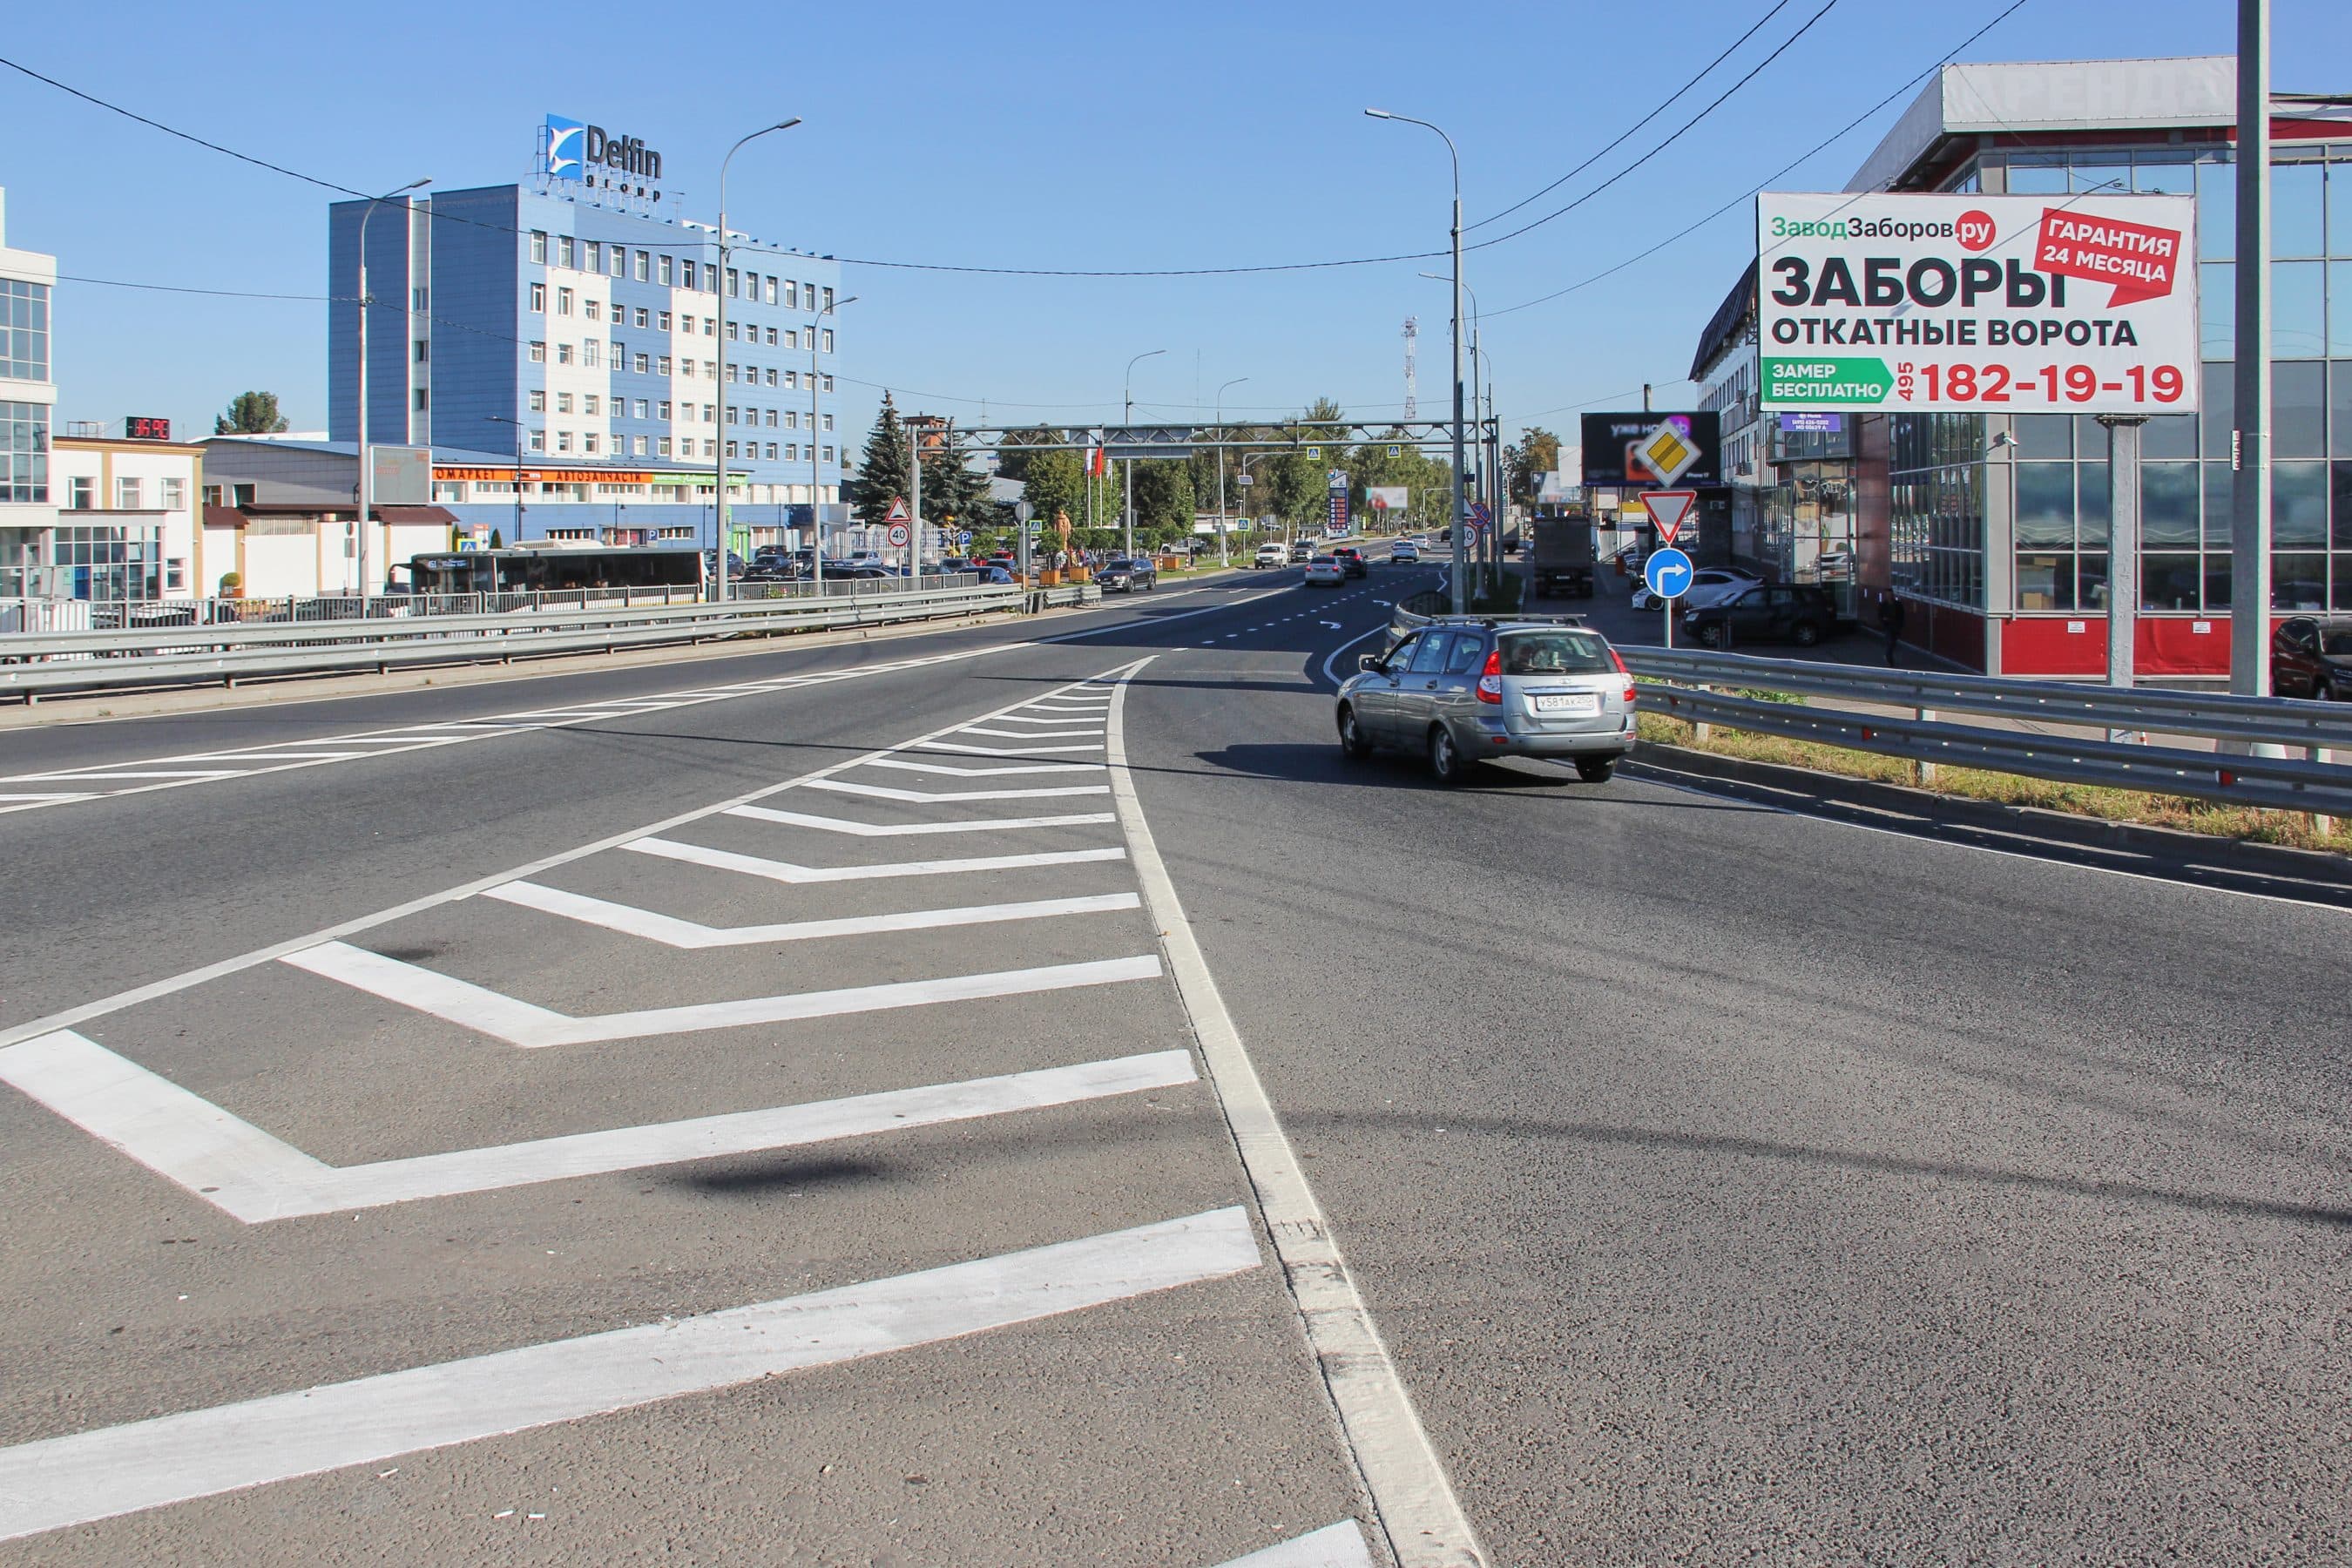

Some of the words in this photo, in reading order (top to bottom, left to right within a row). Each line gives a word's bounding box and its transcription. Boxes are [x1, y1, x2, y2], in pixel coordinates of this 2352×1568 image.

[587, 125, 661, 179] Delfin
[586, 174, 660, 202] group
[2048, 219, 2173, 257] ГАРАНТИЯ
[2043, 245, 2069, 264] 24
[2075, 250, 2166, 282] МЕСЯЦА
[1771, 256, 2065, 308] ЗАБОРЫ
[1771, 318, 1977, 346] ОТКАТНЫЕ
[1987, 320, 2138, 346] ВОРОТА
[1772, 363, 1836, 378] ЗАМЕР
[1897, 362, 1914, 402] 495
[1920, 363, 2184, 402] 182-19-19
[1772, 382, 1882, 398] БЕСПЛАТНО
[556, 470, 641, 482] АВТОЗАПЧАСТИ
[892, 530, 906, 539] 40
